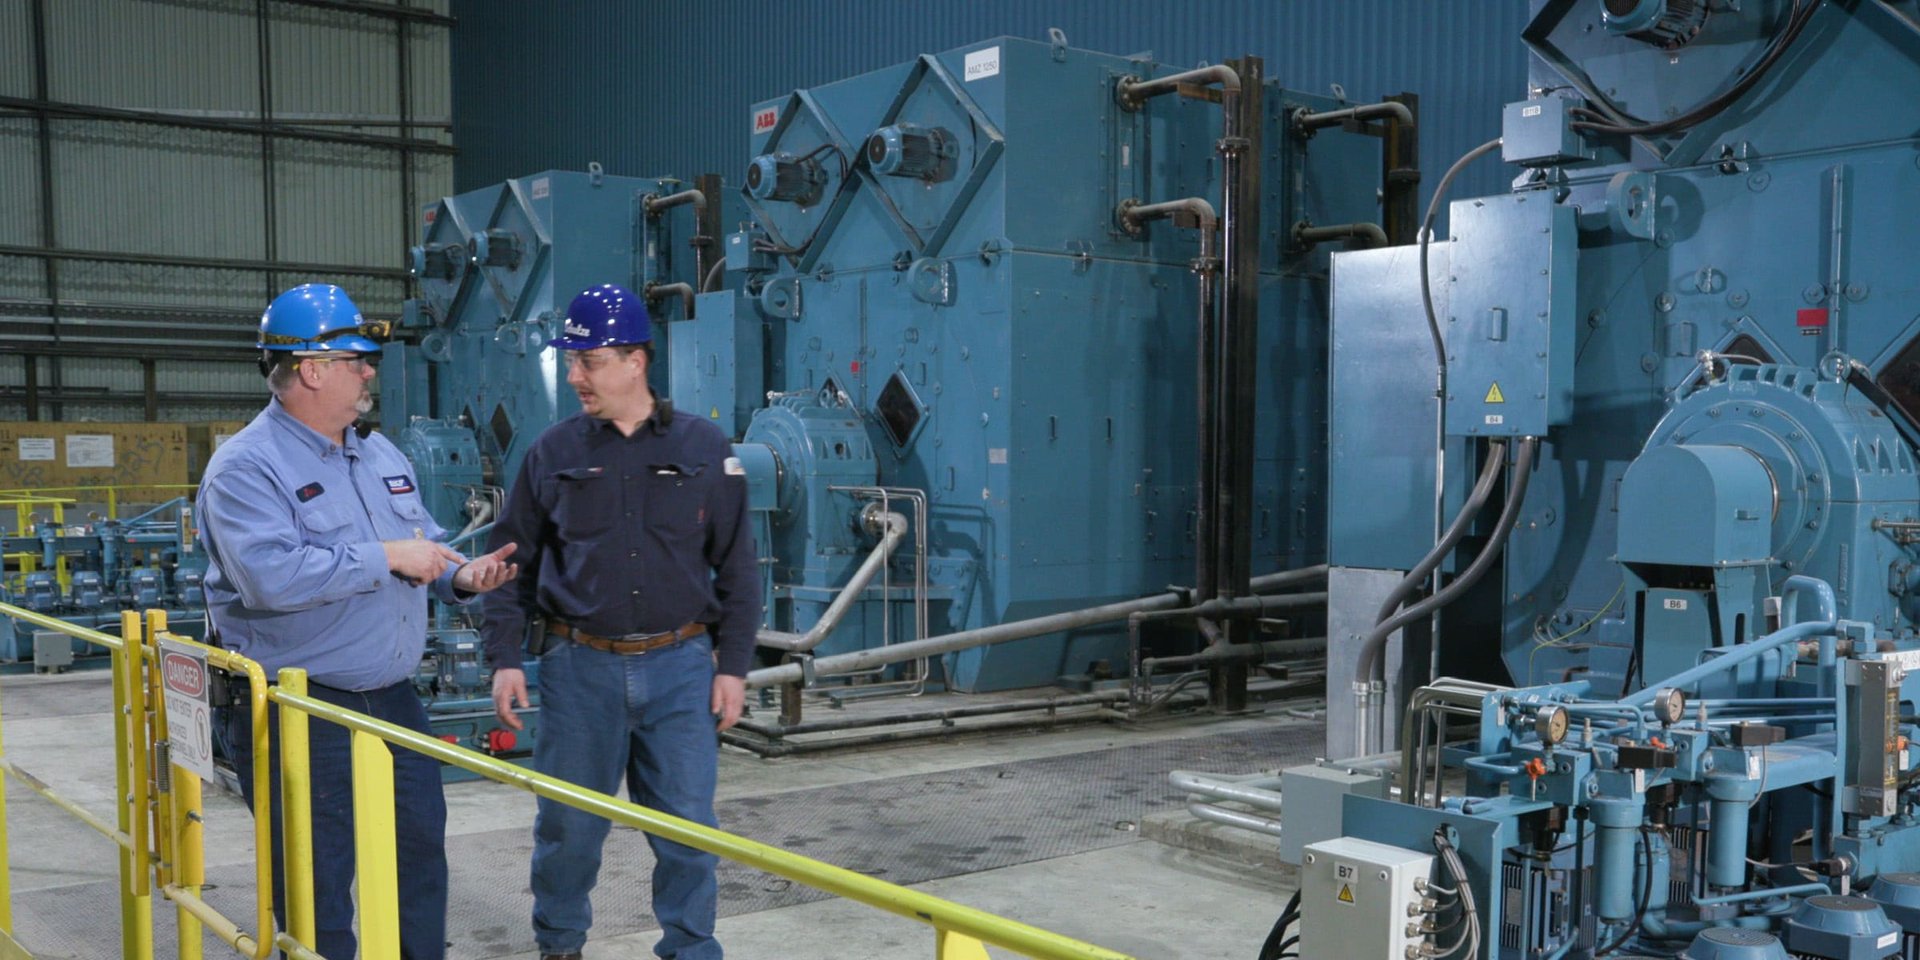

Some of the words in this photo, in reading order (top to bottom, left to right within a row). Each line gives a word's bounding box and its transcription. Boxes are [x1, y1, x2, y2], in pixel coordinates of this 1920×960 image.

[757, 111, 775, 130] ABB
[1669, 600, 1682, 609] B6
[168, 660, 199, 689] DANGER
[1338, 865, 1354, 879] B7
